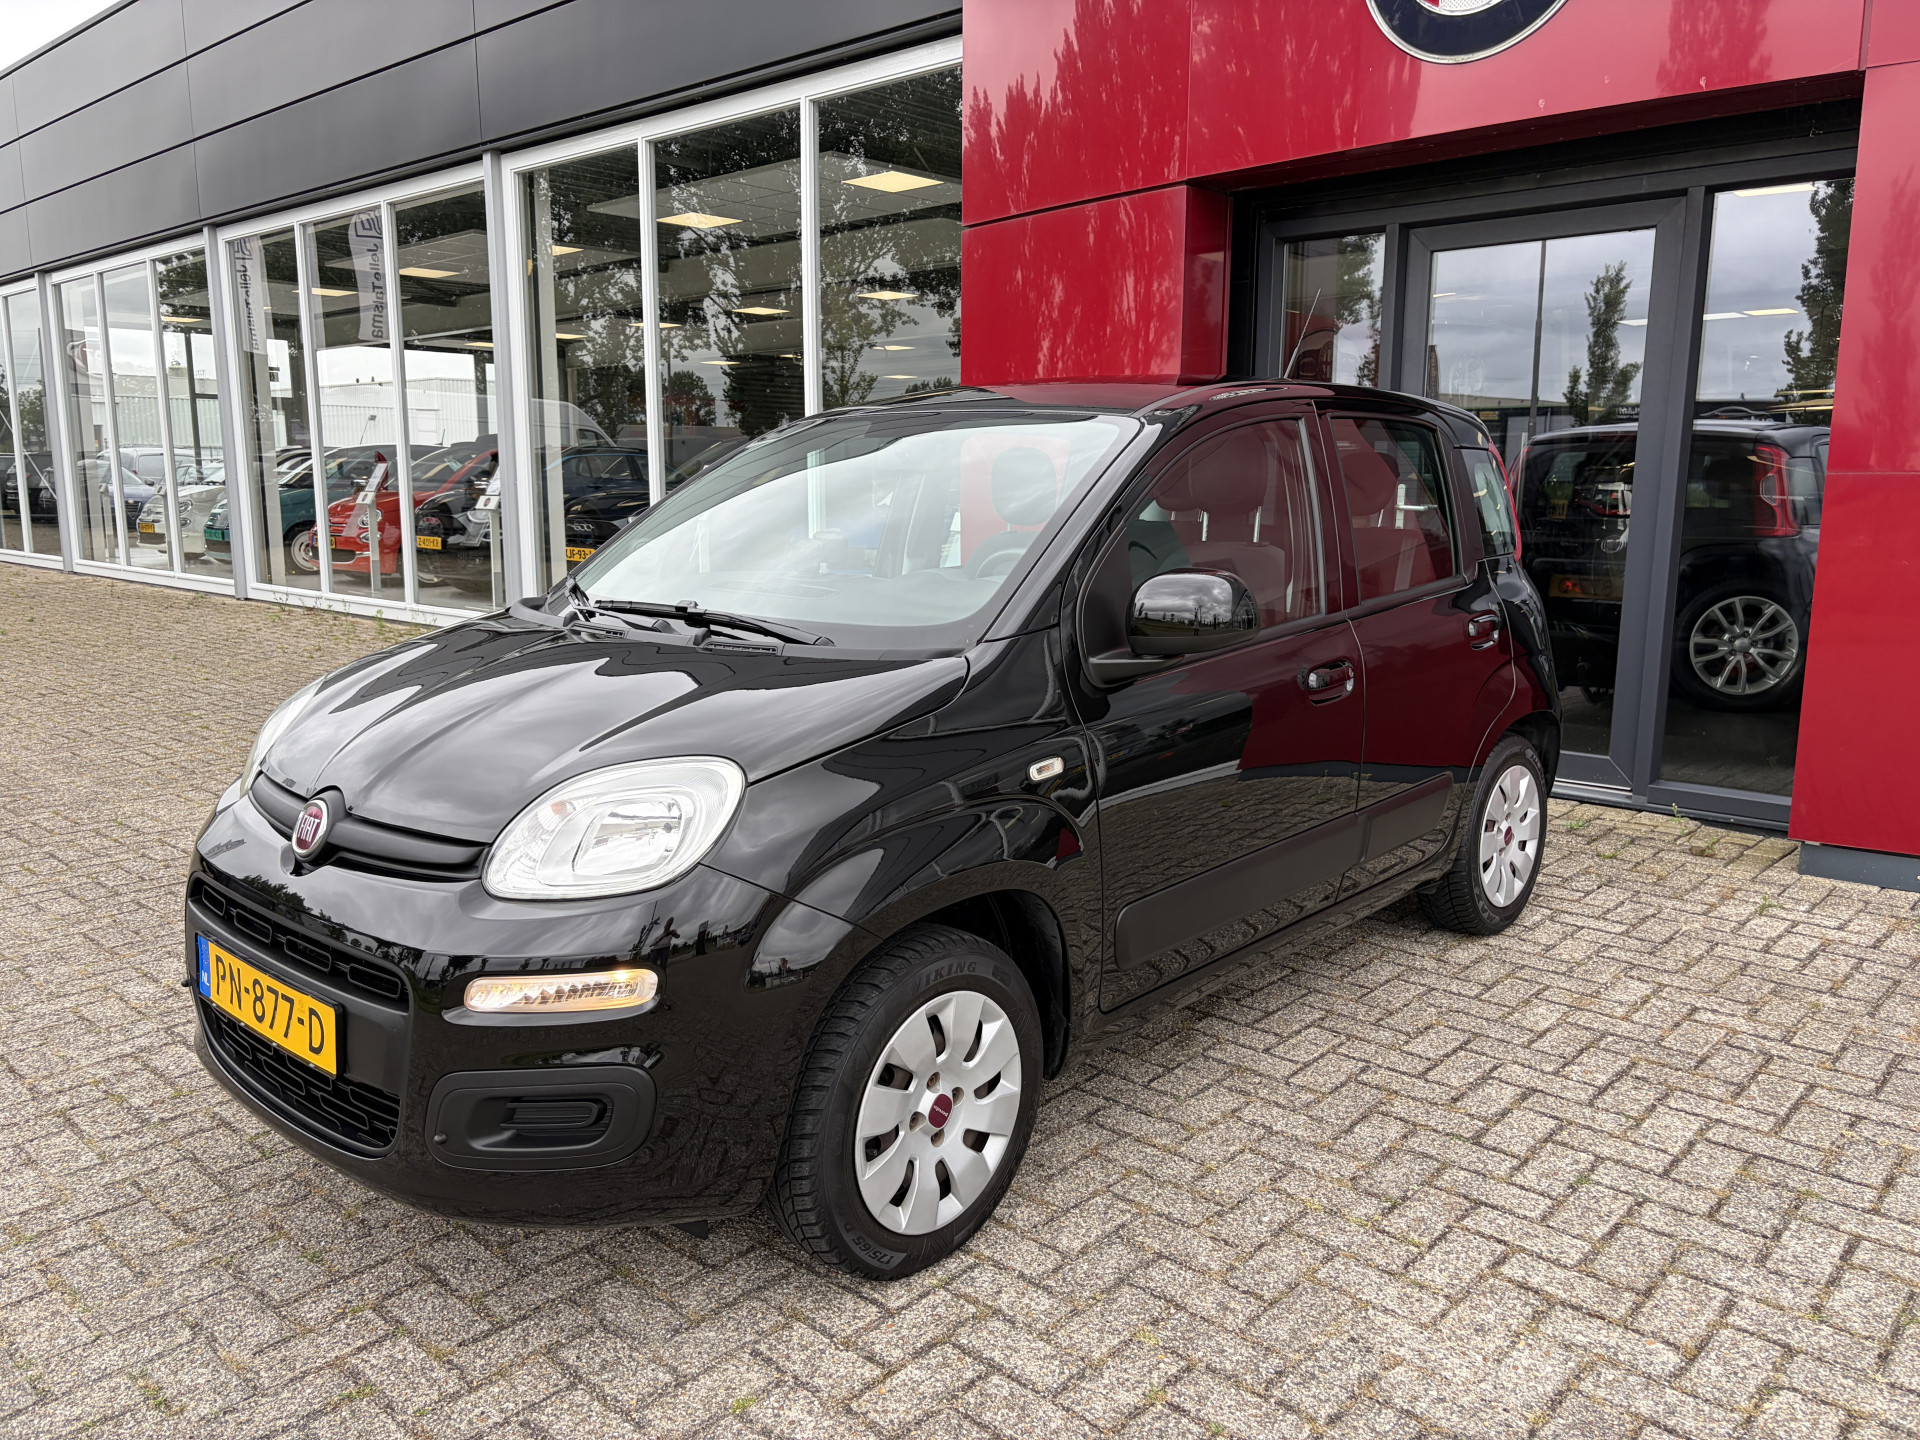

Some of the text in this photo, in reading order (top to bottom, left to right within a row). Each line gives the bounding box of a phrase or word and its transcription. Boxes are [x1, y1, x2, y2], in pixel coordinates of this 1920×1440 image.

[298, 815, 320, 842] FIAT
[201, 971, 210, 987] NL
[215, 953, 325, 1056] PN-877-D
